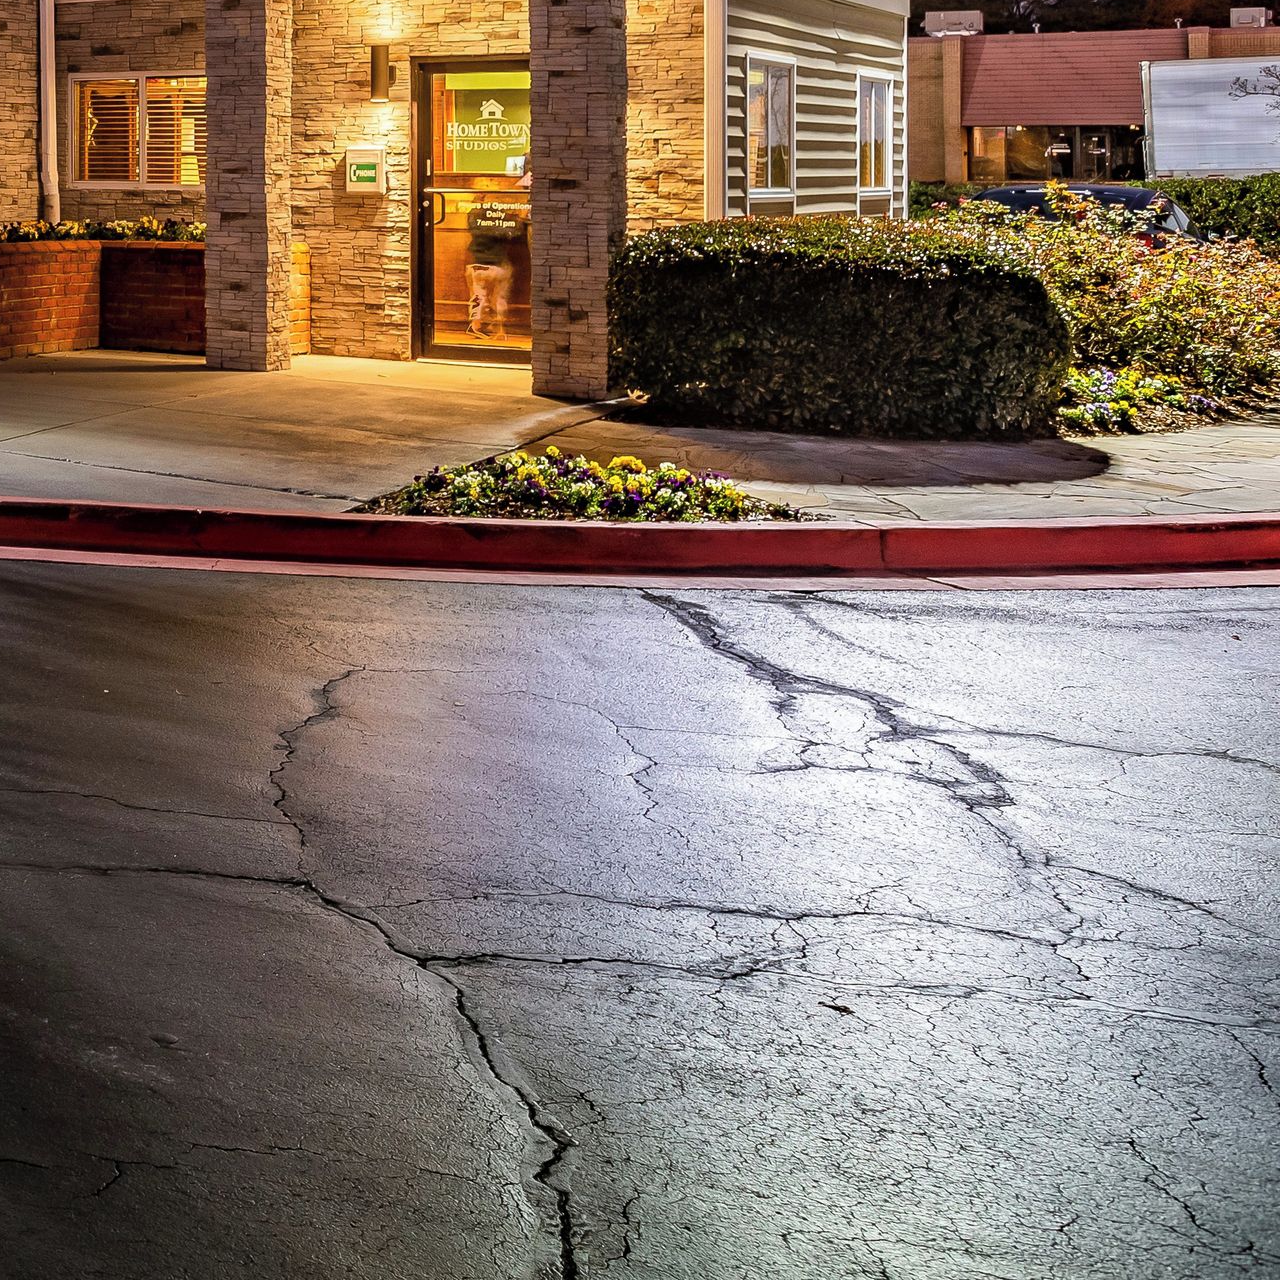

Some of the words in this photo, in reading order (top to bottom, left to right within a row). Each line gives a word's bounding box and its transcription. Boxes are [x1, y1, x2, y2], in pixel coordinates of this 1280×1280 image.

[447, 122, 531, 137] HOMETOWN
[446, 141, 507, 151] STUDIOS
[356, 169, 376, 177] PHONE
[486, 210, 506, 219] Daily
[476, 219, 516, 228] 7am-11pm
